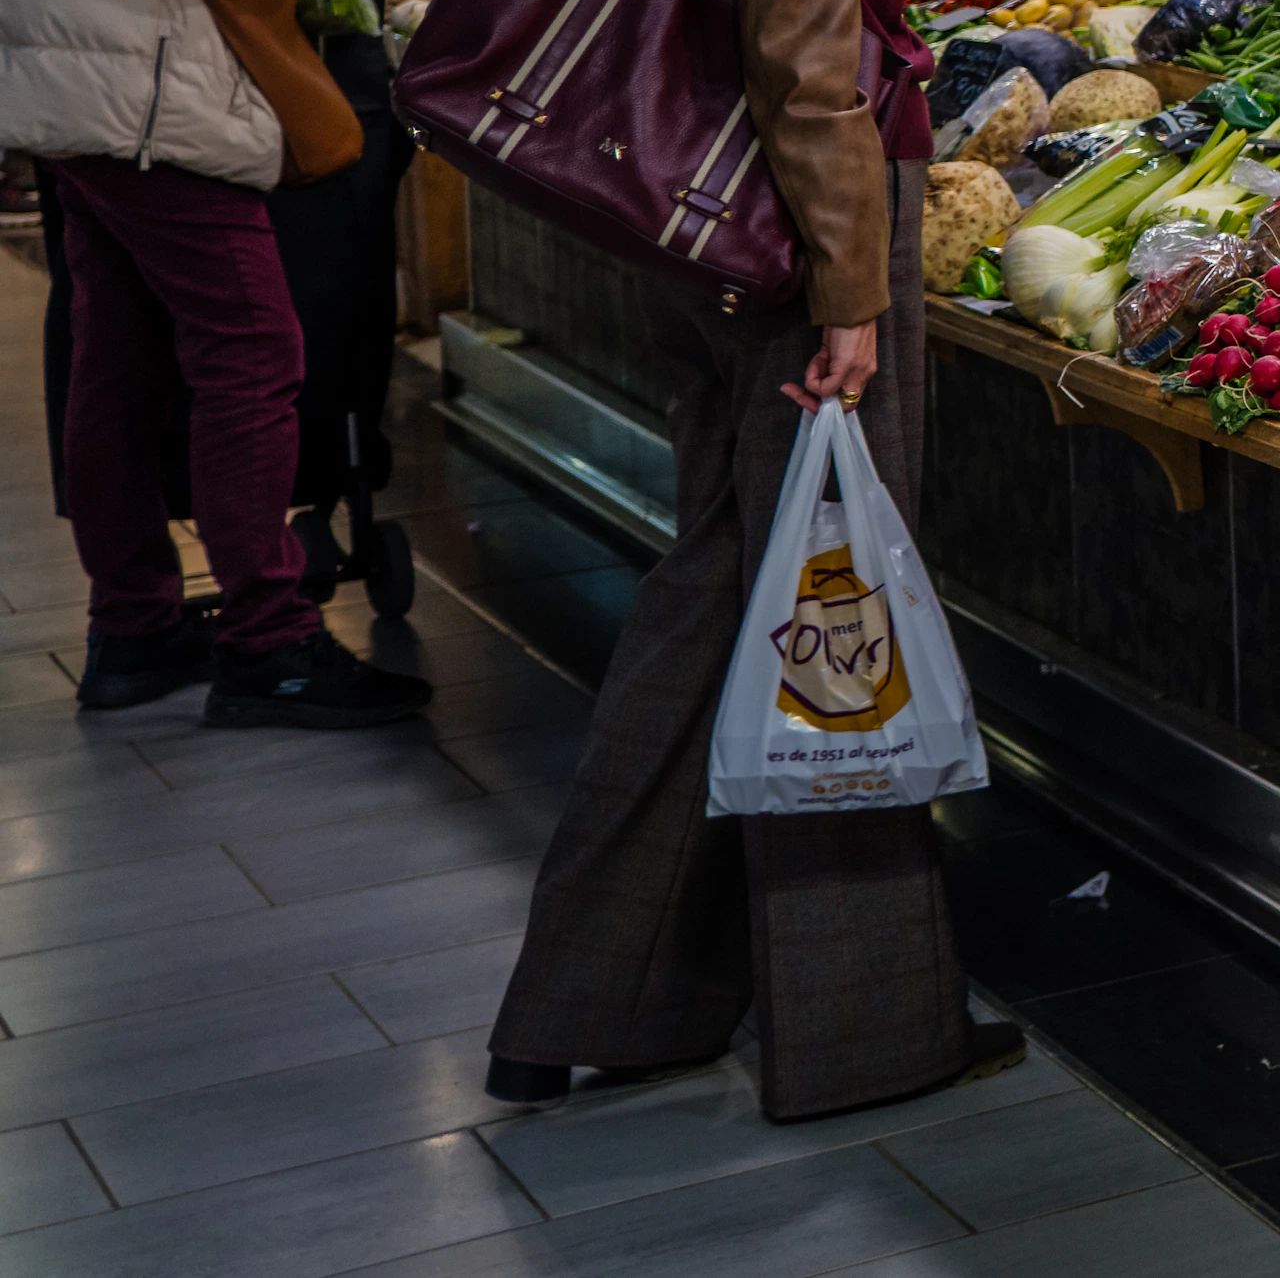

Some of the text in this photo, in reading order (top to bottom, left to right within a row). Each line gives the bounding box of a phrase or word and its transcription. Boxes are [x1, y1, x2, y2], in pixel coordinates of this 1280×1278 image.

[831, 620, 864, 637] mer
[790, 749, 807, 762] de
[811, 748, 844, 763] 1951
[848, 746, 864, 759] al
